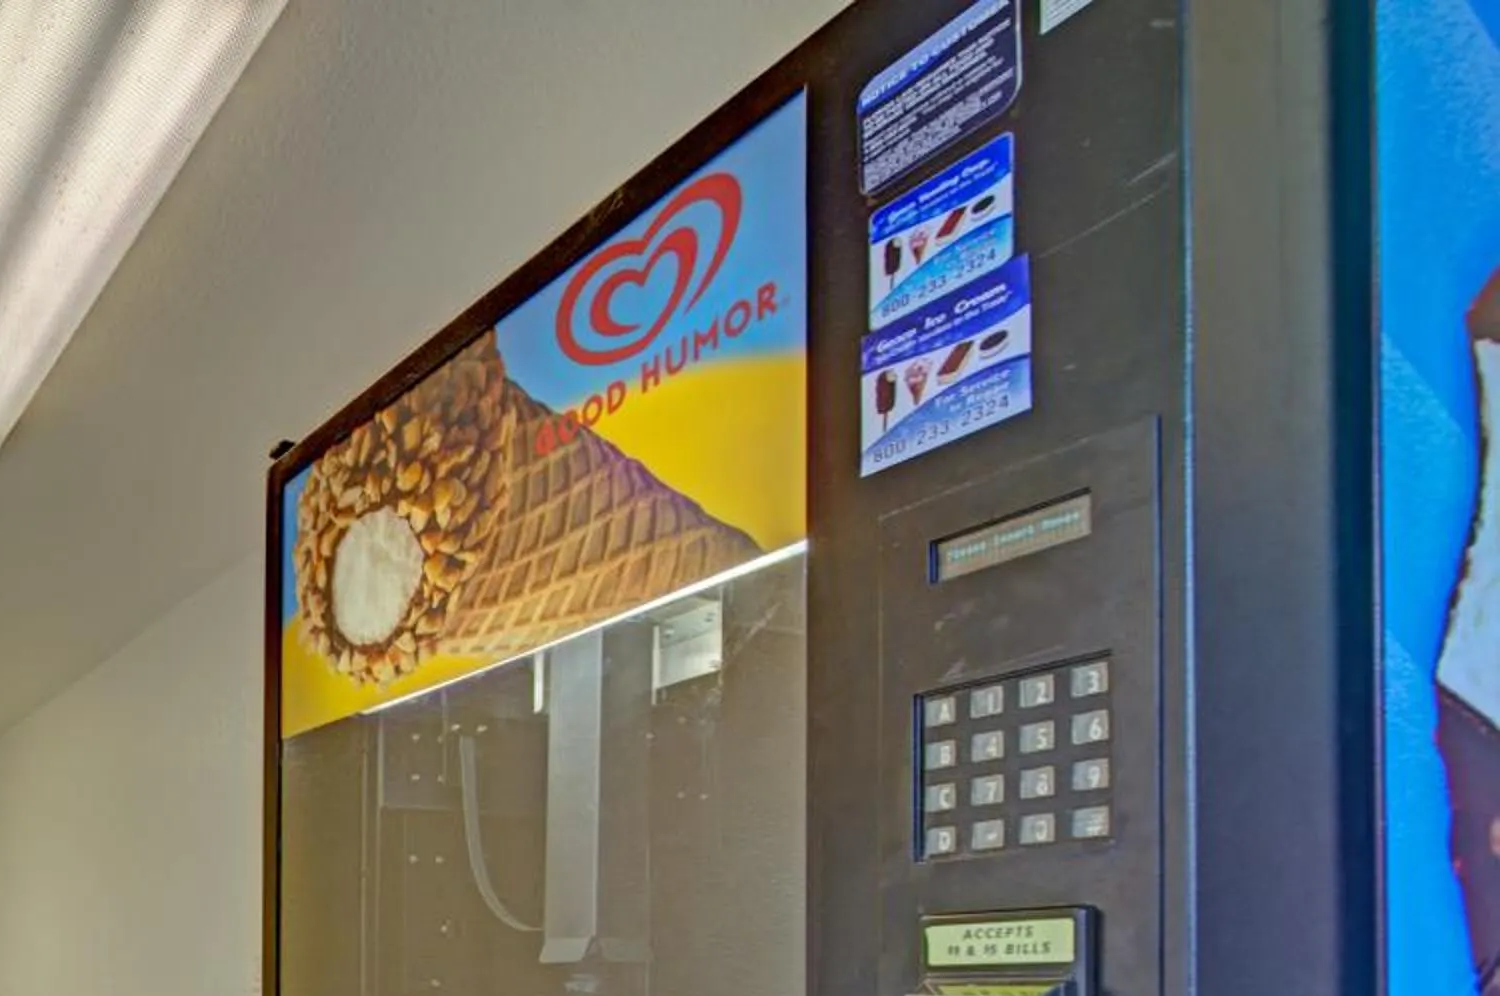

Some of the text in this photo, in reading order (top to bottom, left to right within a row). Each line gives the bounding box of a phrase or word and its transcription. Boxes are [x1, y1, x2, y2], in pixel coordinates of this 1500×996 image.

[535, 380, 627, 456] GOOD
[640, 281, 778, 393] HUMOR
[962, 925, 1035, 941] ACCEPTS
[1004, 941, 1053, 956] BILLS
